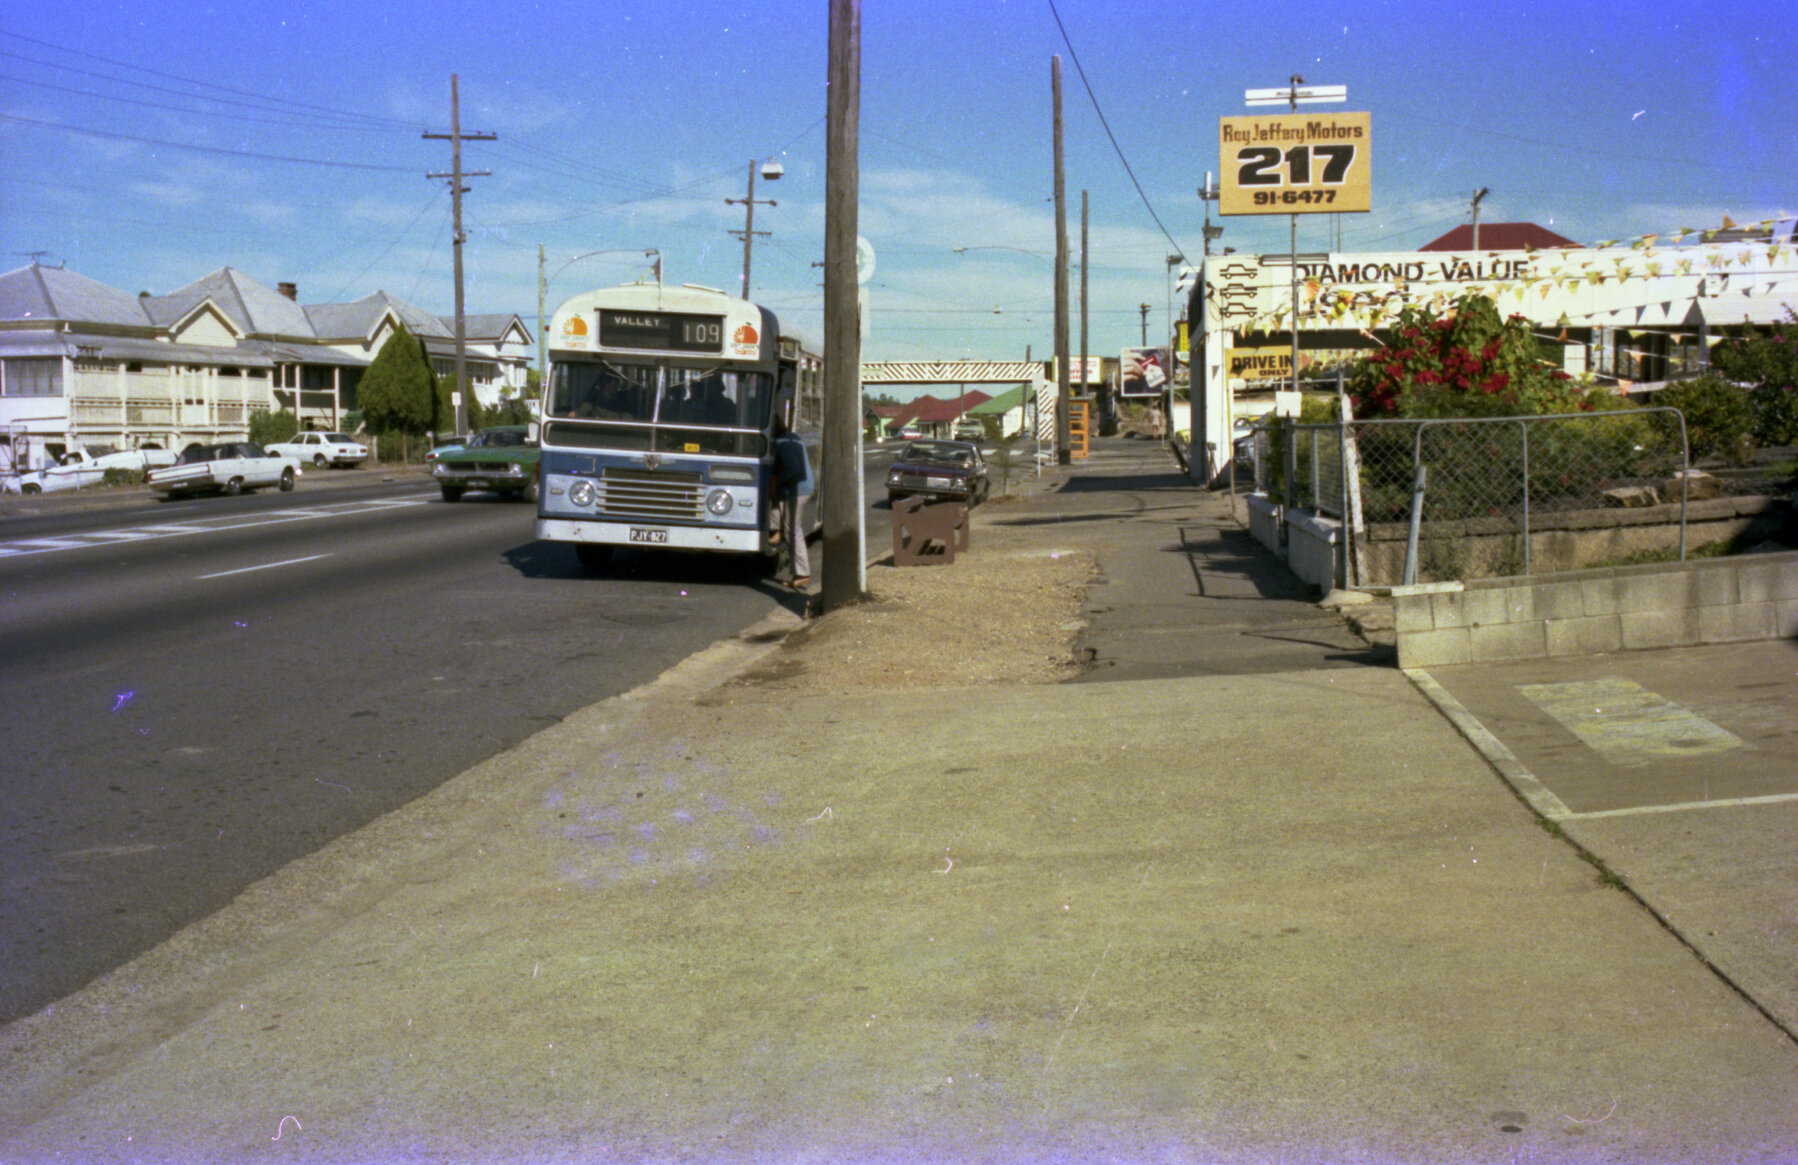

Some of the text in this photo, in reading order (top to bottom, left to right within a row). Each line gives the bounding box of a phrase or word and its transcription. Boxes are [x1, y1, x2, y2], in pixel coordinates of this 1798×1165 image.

[1223, 121, 1363, 145] Ray Jeffery Motors
[1237, 144, 1356, 187] 217
[1253, 189, 1337, 206] 91-6477
[614, 316, 661, 327] VALLEY
[683, 323, 720, 344] 109
[1231, 354, 1293, 369] DRIVE IN
[1259, 368, 1288, 376] ONLY
